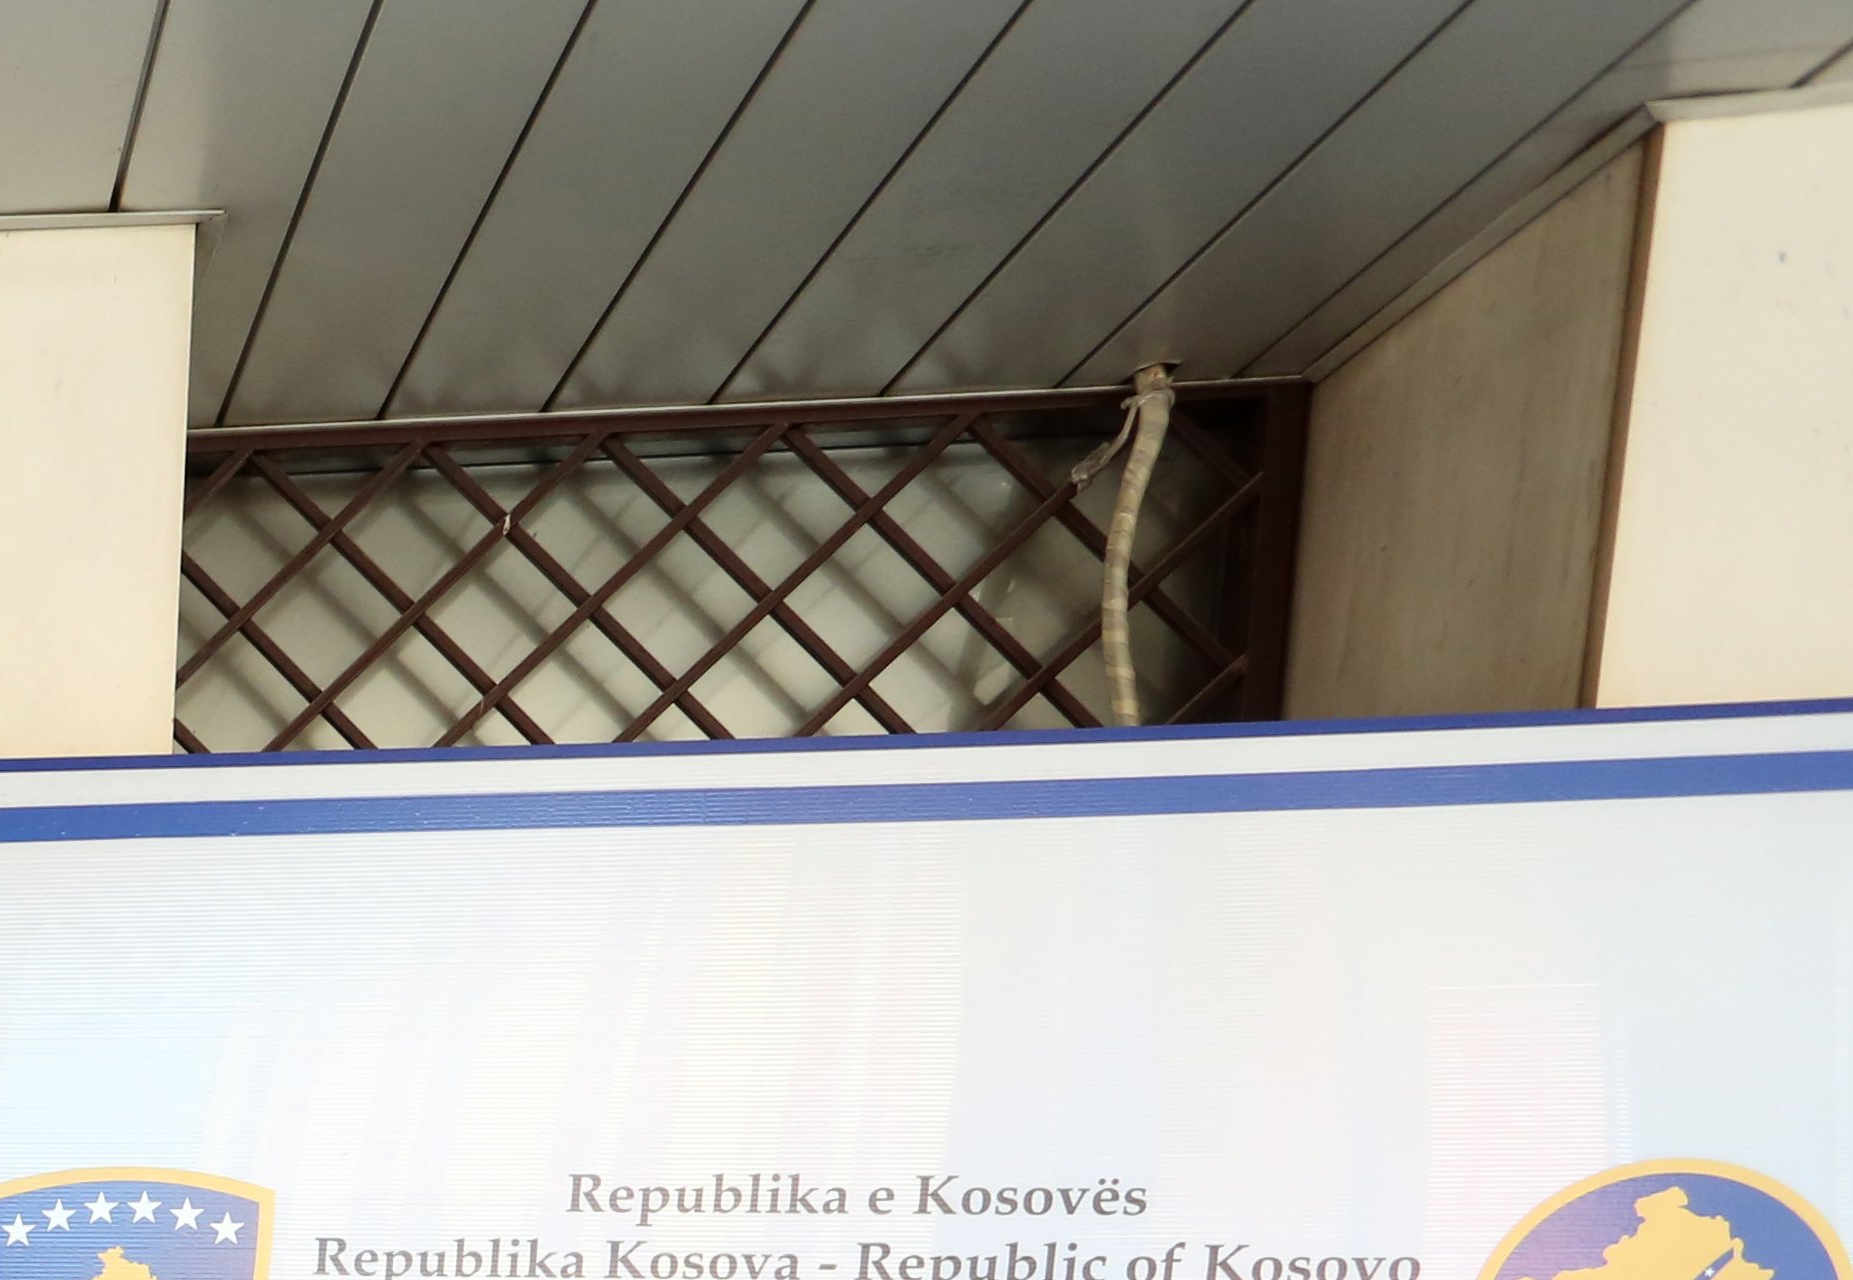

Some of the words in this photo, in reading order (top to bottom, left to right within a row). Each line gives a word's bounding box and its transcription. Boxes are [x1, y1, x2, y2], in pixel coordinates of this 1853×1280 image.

[566, 1173, 849, 1227] Republika
[868, 1187, 895, 1215] e
[912, 1175, 1148, 1217] Kosovës
[604, 1240, 801, 1280] Kosova
